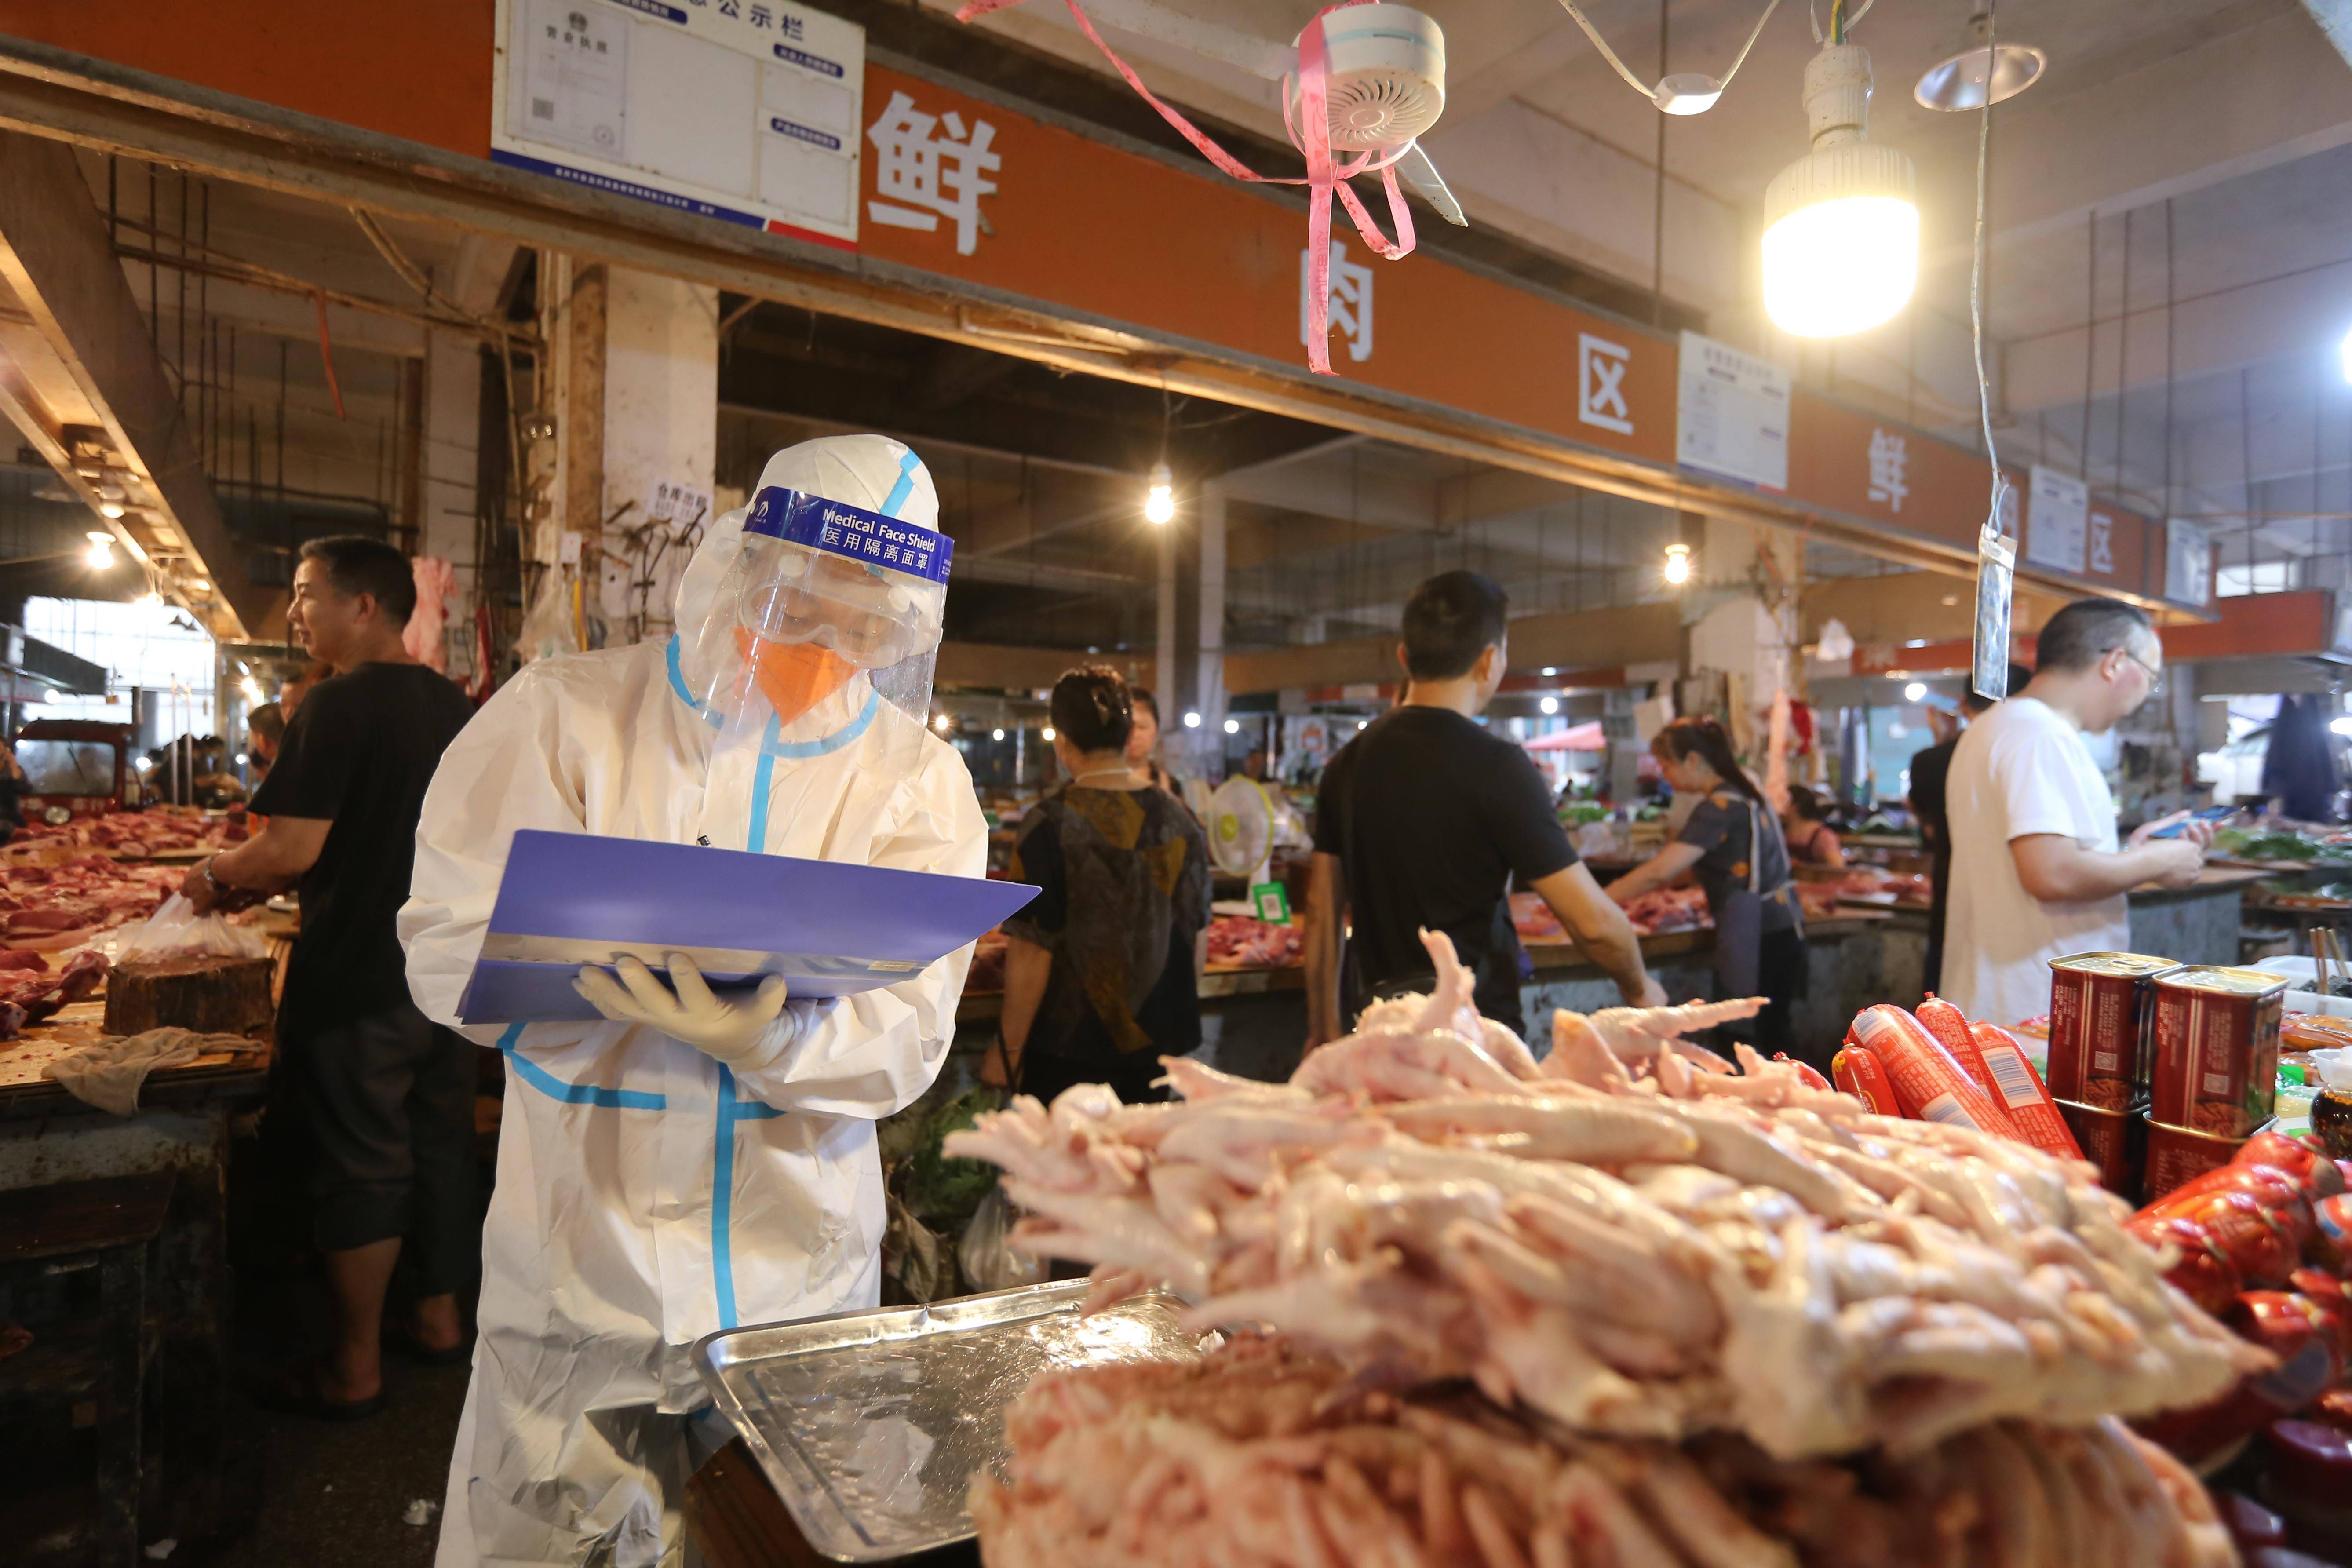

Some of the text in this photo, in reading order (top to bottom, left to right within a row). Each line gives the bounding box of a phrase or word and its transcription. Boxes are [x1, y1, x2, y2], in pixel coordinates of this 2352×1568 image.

[866, 90, 1002, 257] 鲜
[1299, 239, 1374, 363] 肉
[1578, 332, 1634, 436] 区
[822, 508, 936, 553] Medical Face Shield
[823, 526, 929, 570] 医用隔离面罩
[1867, 428, 1909, 513] 鲜
[2090, 512, 2113, 573] 区
